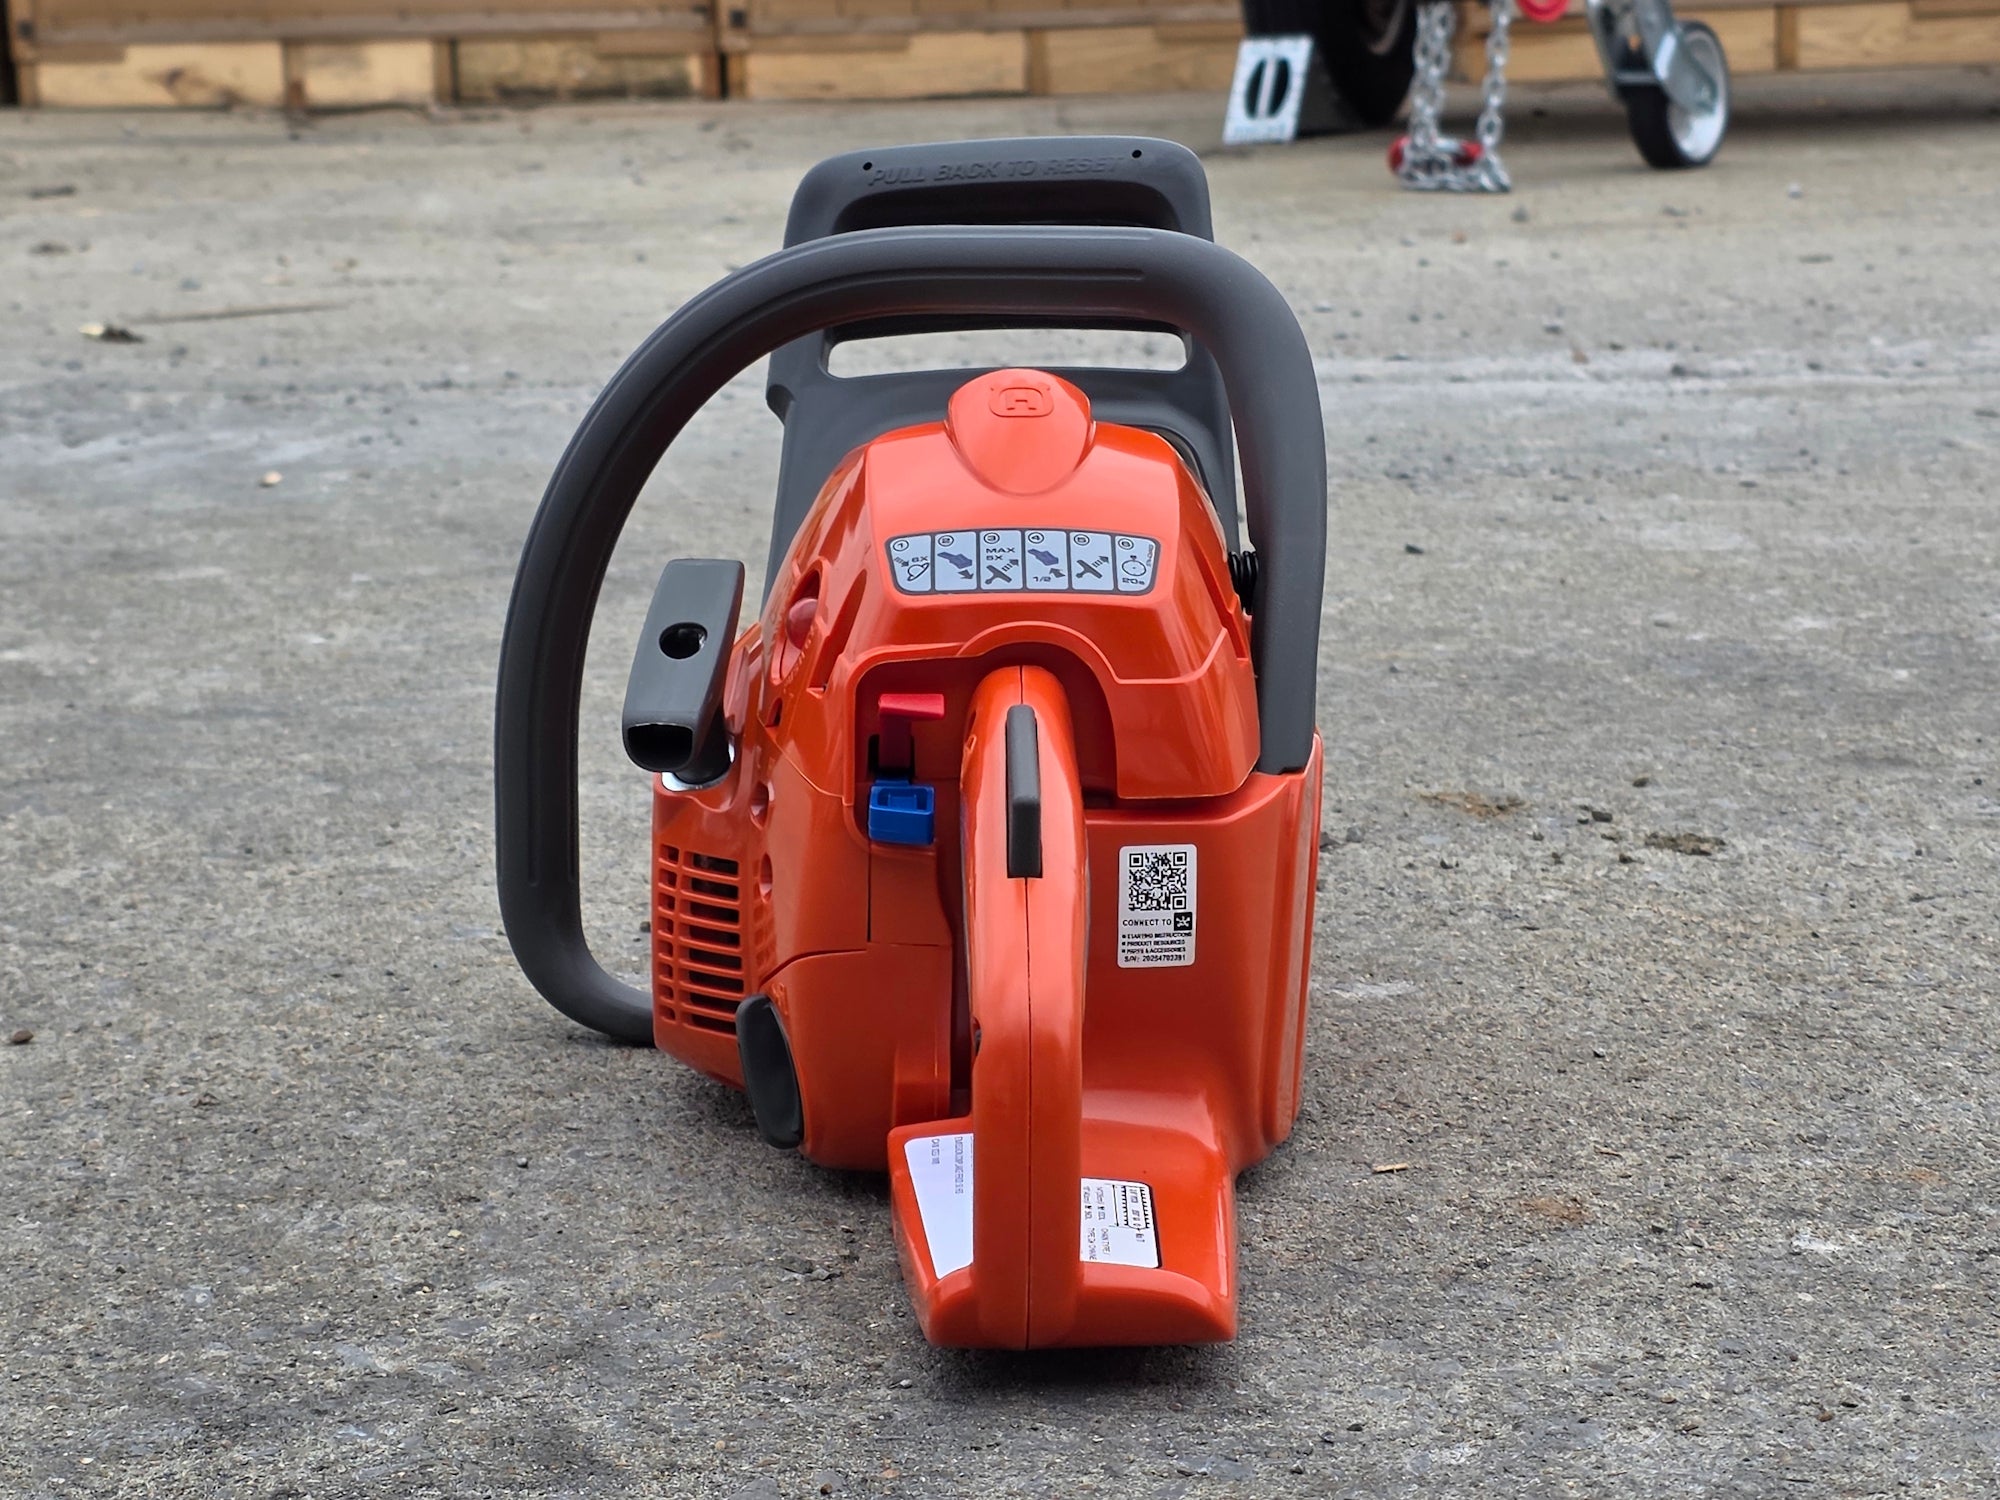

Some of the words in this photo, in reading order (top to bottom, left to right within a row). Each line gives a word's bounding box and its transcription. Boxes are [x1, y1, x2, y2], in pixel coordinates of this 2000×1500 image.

[868, 166, 926, 187] PULL
[934, 161, 1004, 182] BACK
[1007, 159, 1039, 178] TO
[1043, 156, 1125, 176] RESET
[1161, 918, 1172, 926] TO
